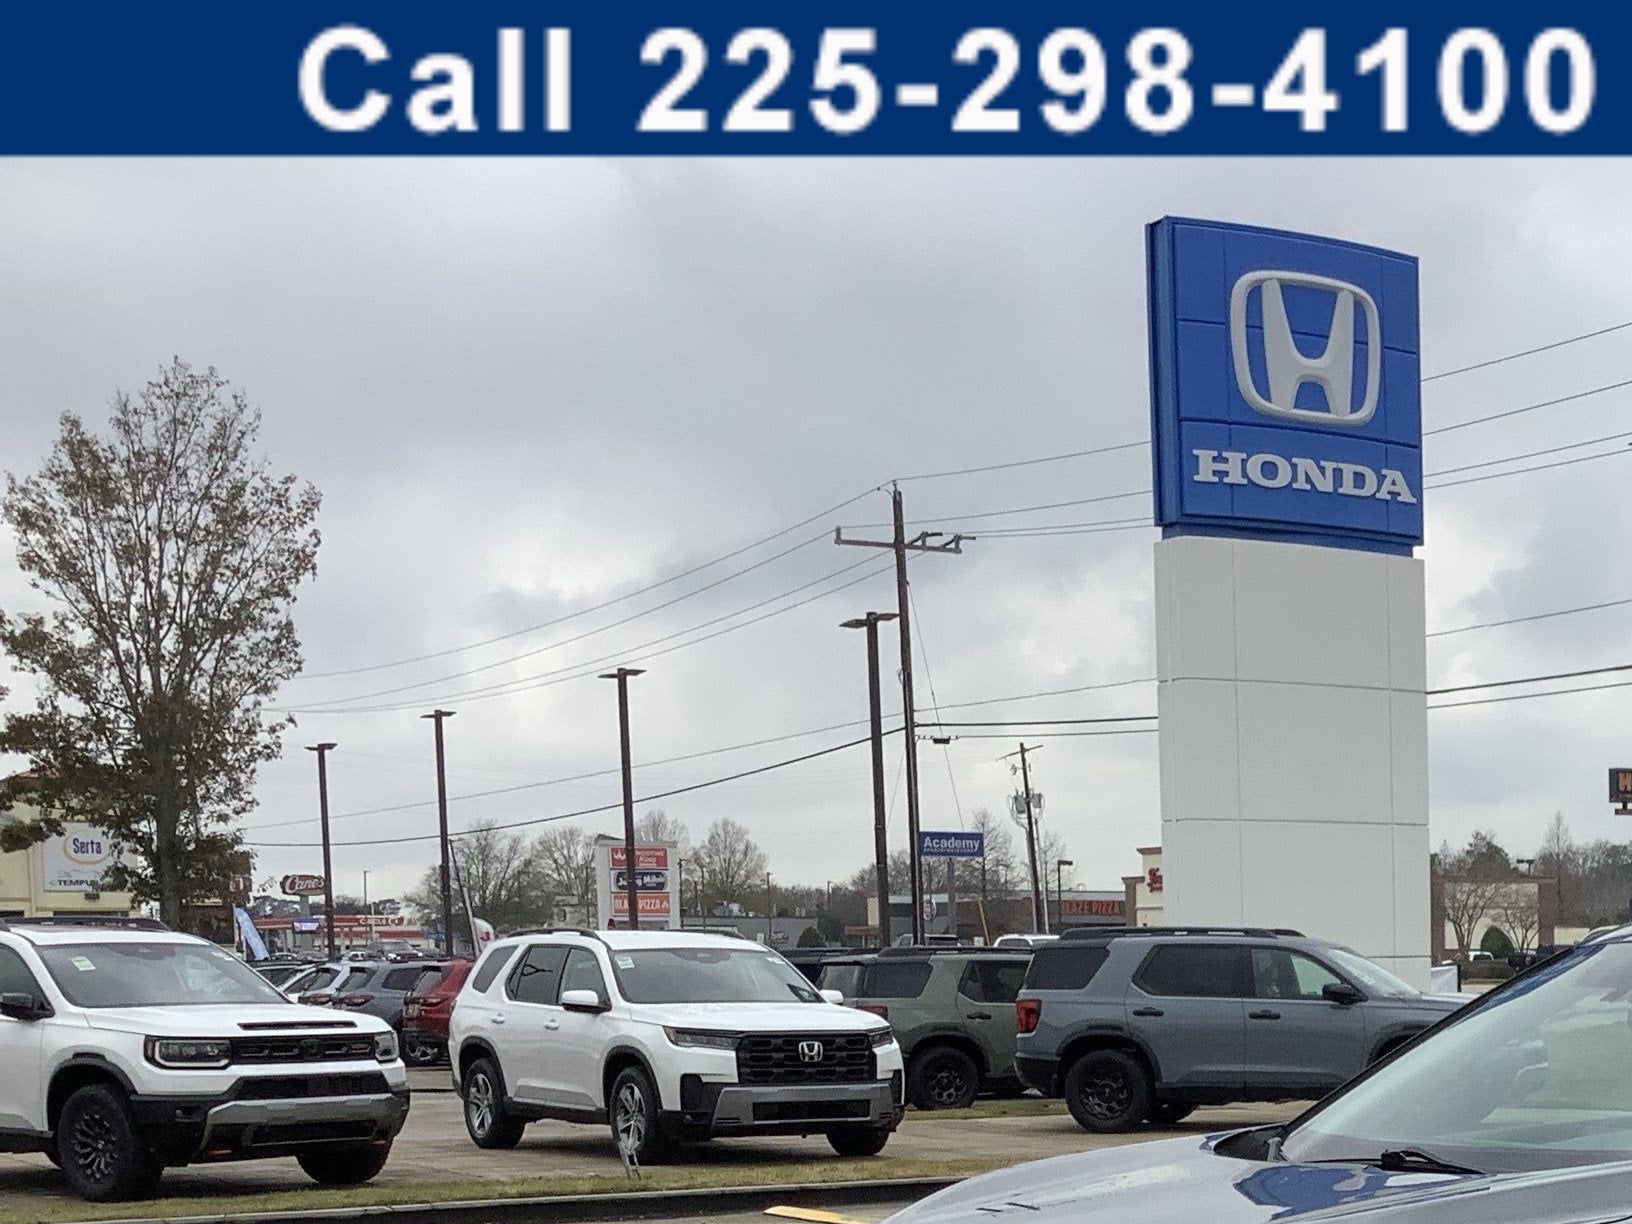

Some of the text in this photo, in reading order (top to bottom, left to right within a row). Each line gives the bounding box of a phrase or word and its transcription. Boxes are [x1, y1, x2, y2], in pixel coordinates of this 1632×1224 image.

[1193, 449, 1417, 504] HONDA
[72, 838, 102, 855] Serta
[923, 836, 980, 852] Academy
